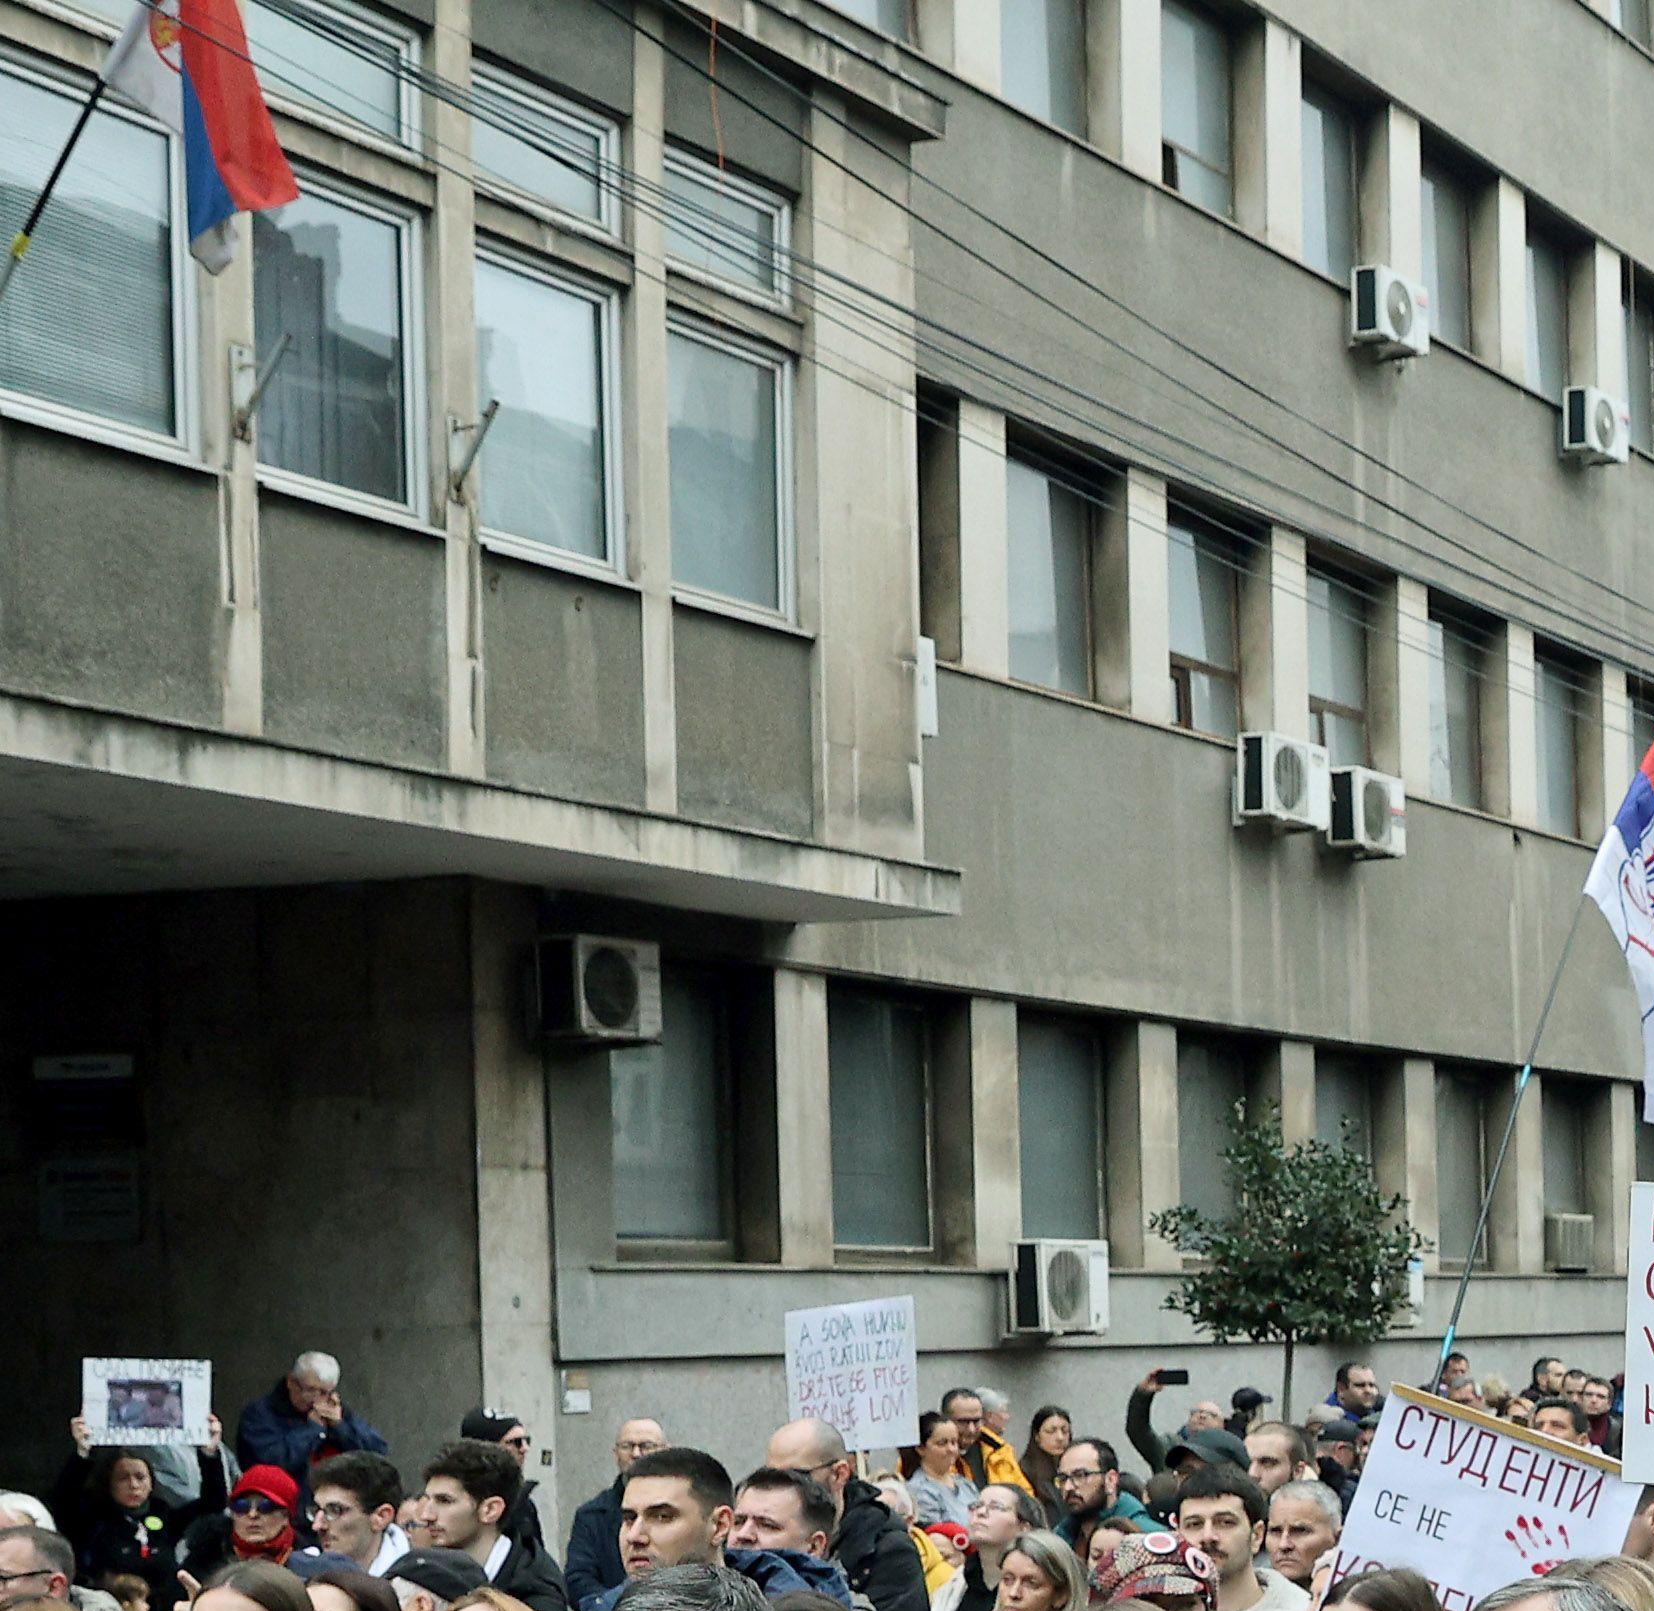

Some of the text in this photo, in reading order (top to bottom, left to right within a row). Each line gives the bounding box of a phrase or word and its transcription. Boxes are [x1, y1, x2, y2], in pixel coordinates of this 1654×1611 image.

[1394, 1403, 1606, 1519] СТУДЕНТИ
[1373, 1489, 1453, 1542] СЕ НЕ
